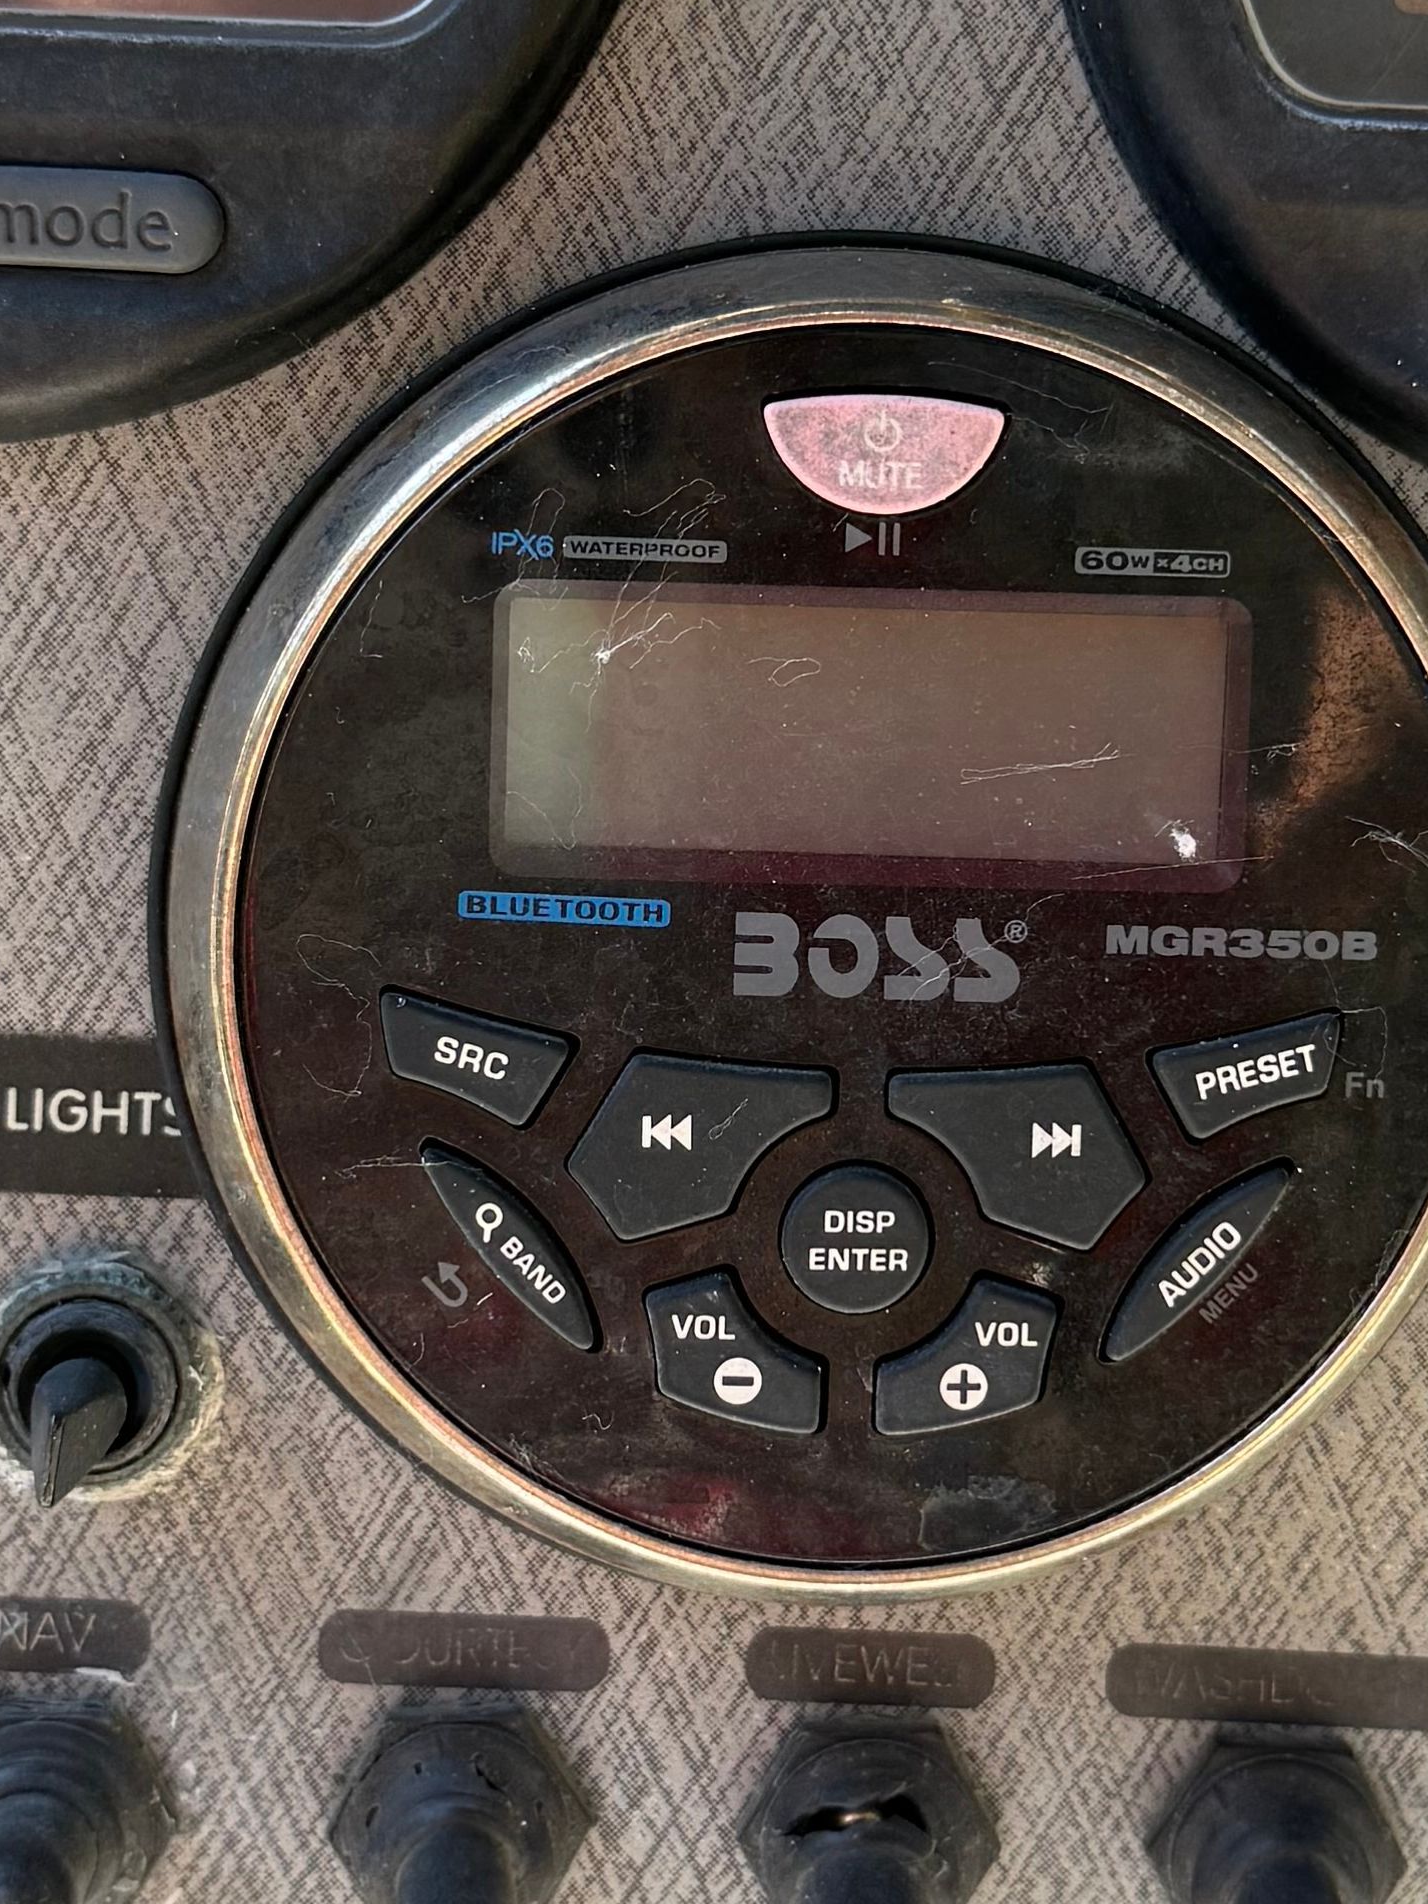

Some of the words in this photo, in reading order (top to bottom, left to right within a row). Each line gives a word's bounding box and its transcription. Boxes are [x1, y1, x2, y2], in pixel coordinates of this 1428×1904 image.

[838, 460, 924, 493] MUTE
[490, 530, 556, 560] IPX6
[568, 540, 724, 560] WATERPROOF
[463, 895, 666, 926] BLUETOOTH
[732, 910, 1021, 1004] BOSS
[1103, 924, 1378, 962] MGR350B
[432, 1034, 510, 1082] SRC
[1195, 1044, 1318, 1101] PRESET
[1345, 1071, 1386, 1100] Fn
[822, 1206, 895, 1235] DISP
[499, 1235, 567, 1305] BAND
[808, 1245, 909, 1274] ENTER
[1157, 1220, 1243, 1309] AUDIO
[1197, 1262, 1260, 1325] MENU
[671, 1313, 736, 1342] VOL
[974, 1320, 1040, 1349] VOL
[769, 1640, 972, 1688] LIVEWE
